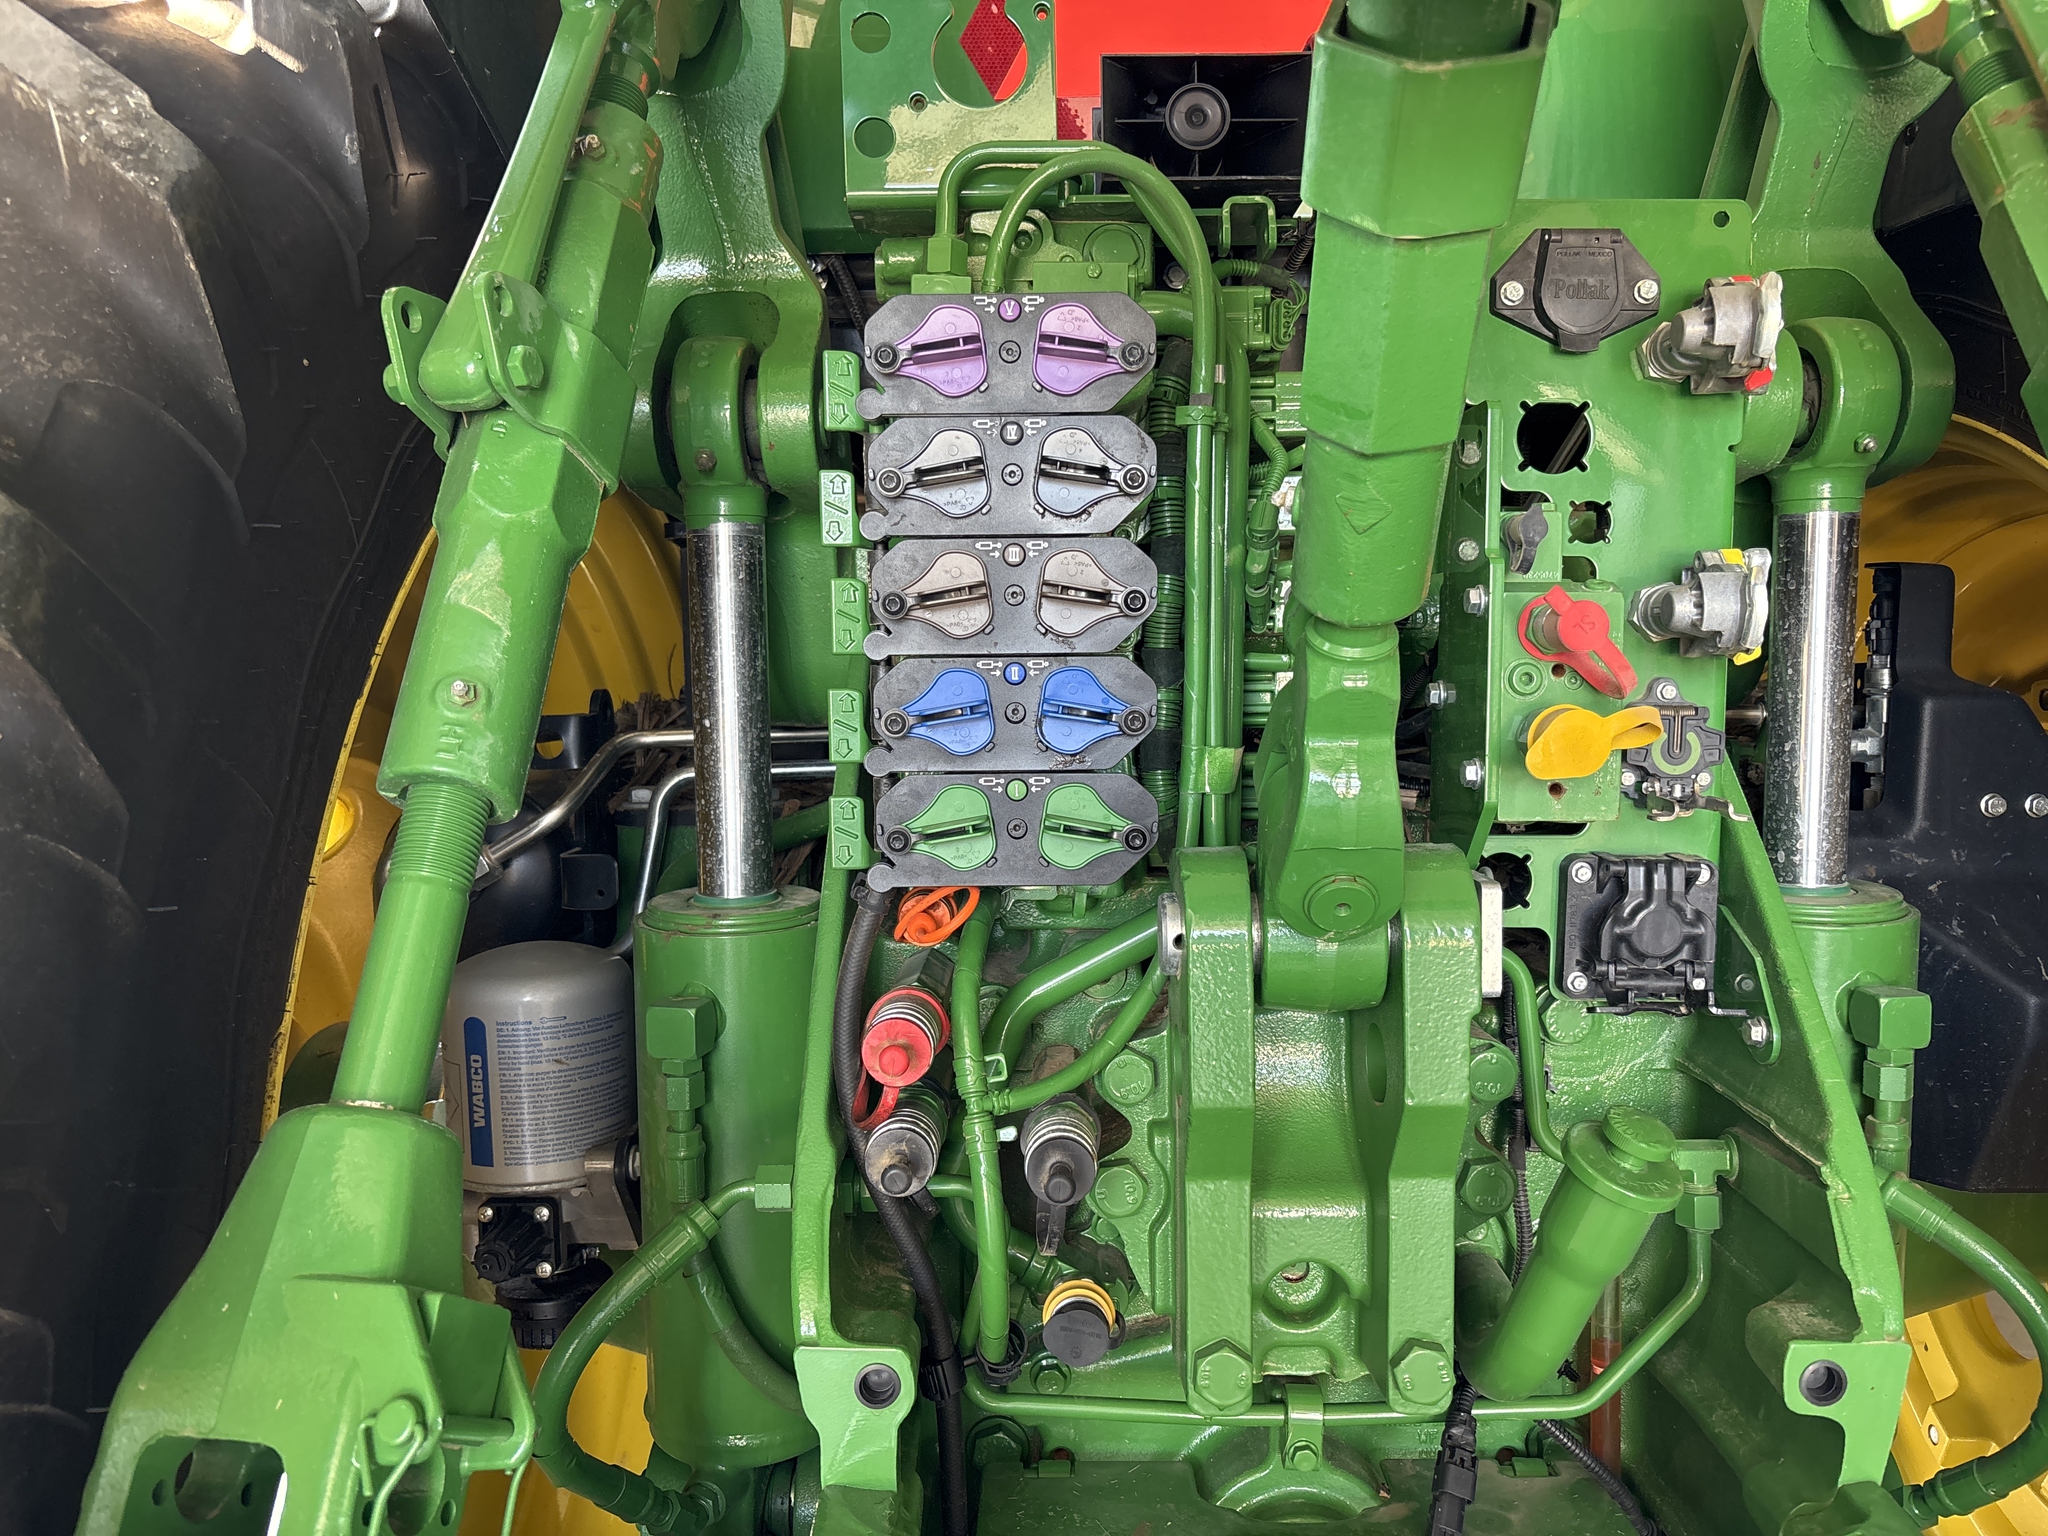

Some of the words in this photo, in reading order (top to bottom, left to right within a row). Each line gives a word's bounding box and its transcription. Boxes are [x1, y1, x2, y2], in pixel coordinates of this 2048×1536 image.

[1554, 278, 1610, 300] Pollak
[1004, 300, 1015, 316] V
[1006, 425, 1018, 440] IV
[1008, 548, 1020, 562] III
[1011, 666, 1019, 680] II
[470, 1054, 486, 1128] WABCO
[1120, 1081, 1146, 1100] 10.9
[1474, 1081, 1502, 1095] 10.9
